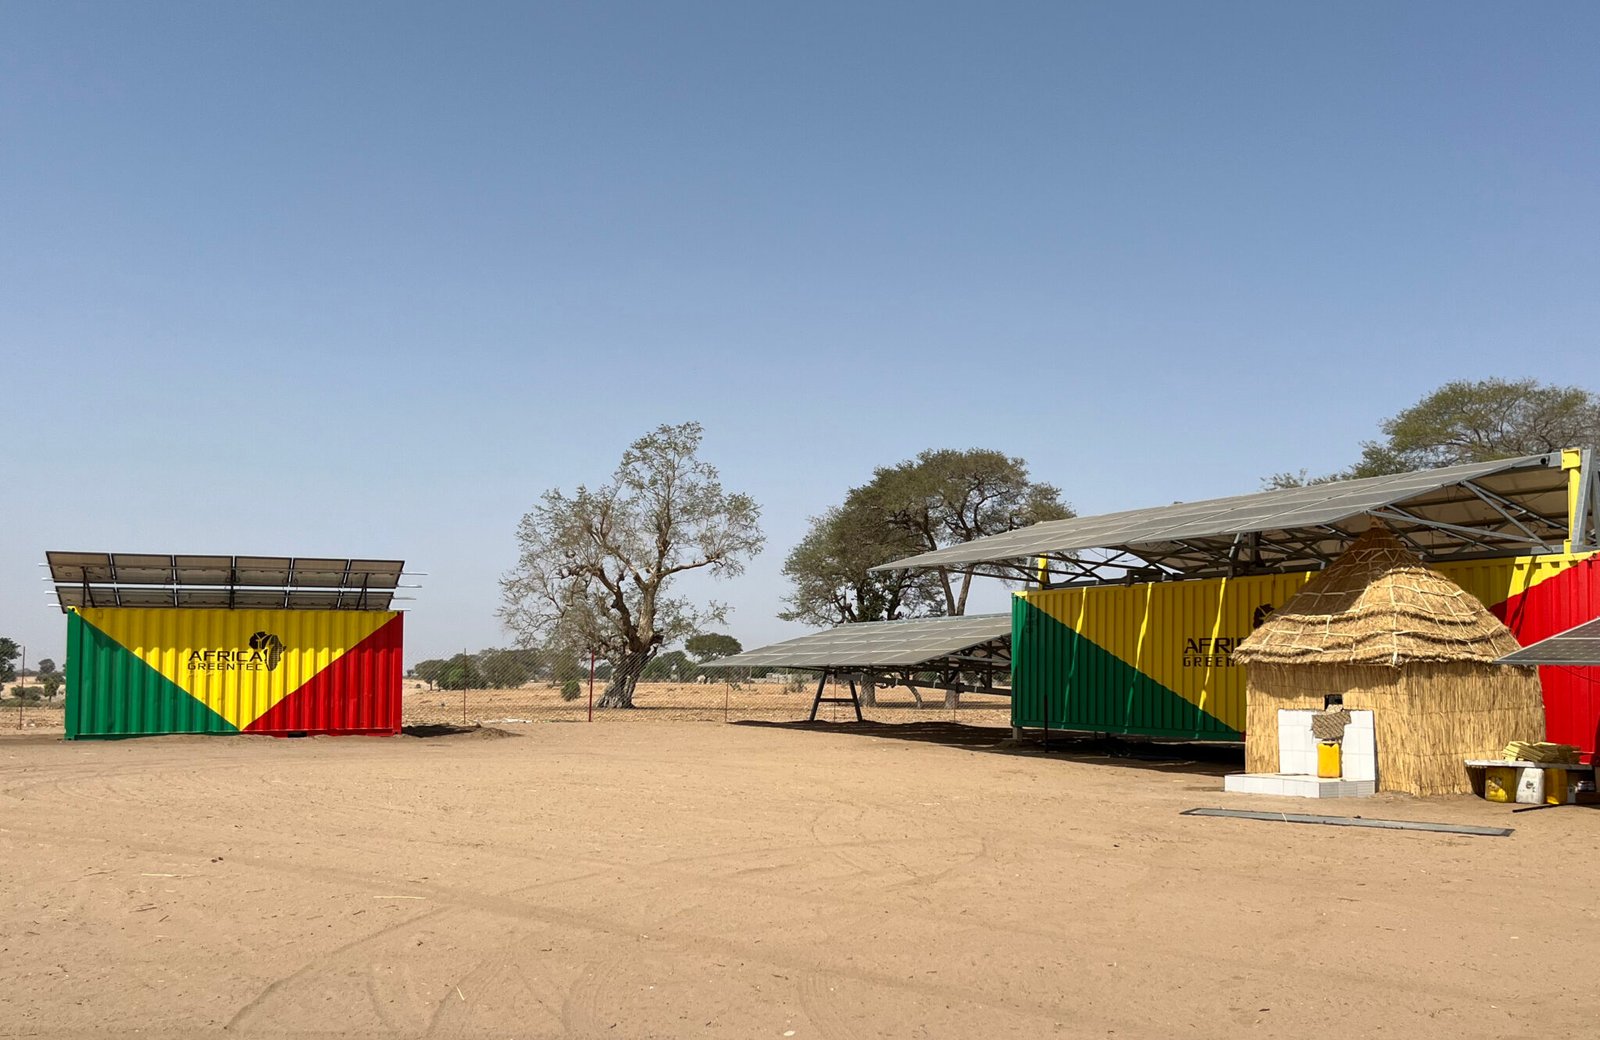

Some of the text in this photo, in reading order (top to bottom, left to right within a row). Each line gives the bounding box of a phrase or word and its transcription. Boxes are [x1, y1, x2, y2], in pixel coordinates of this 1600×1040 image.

[1184, 637, 1247, 654] AFRI
[188, 651, 263, 662] AFRICA
[1183, 656, 1236, 668] GREEN
[187, 663, 263, 671] GREENTEC
